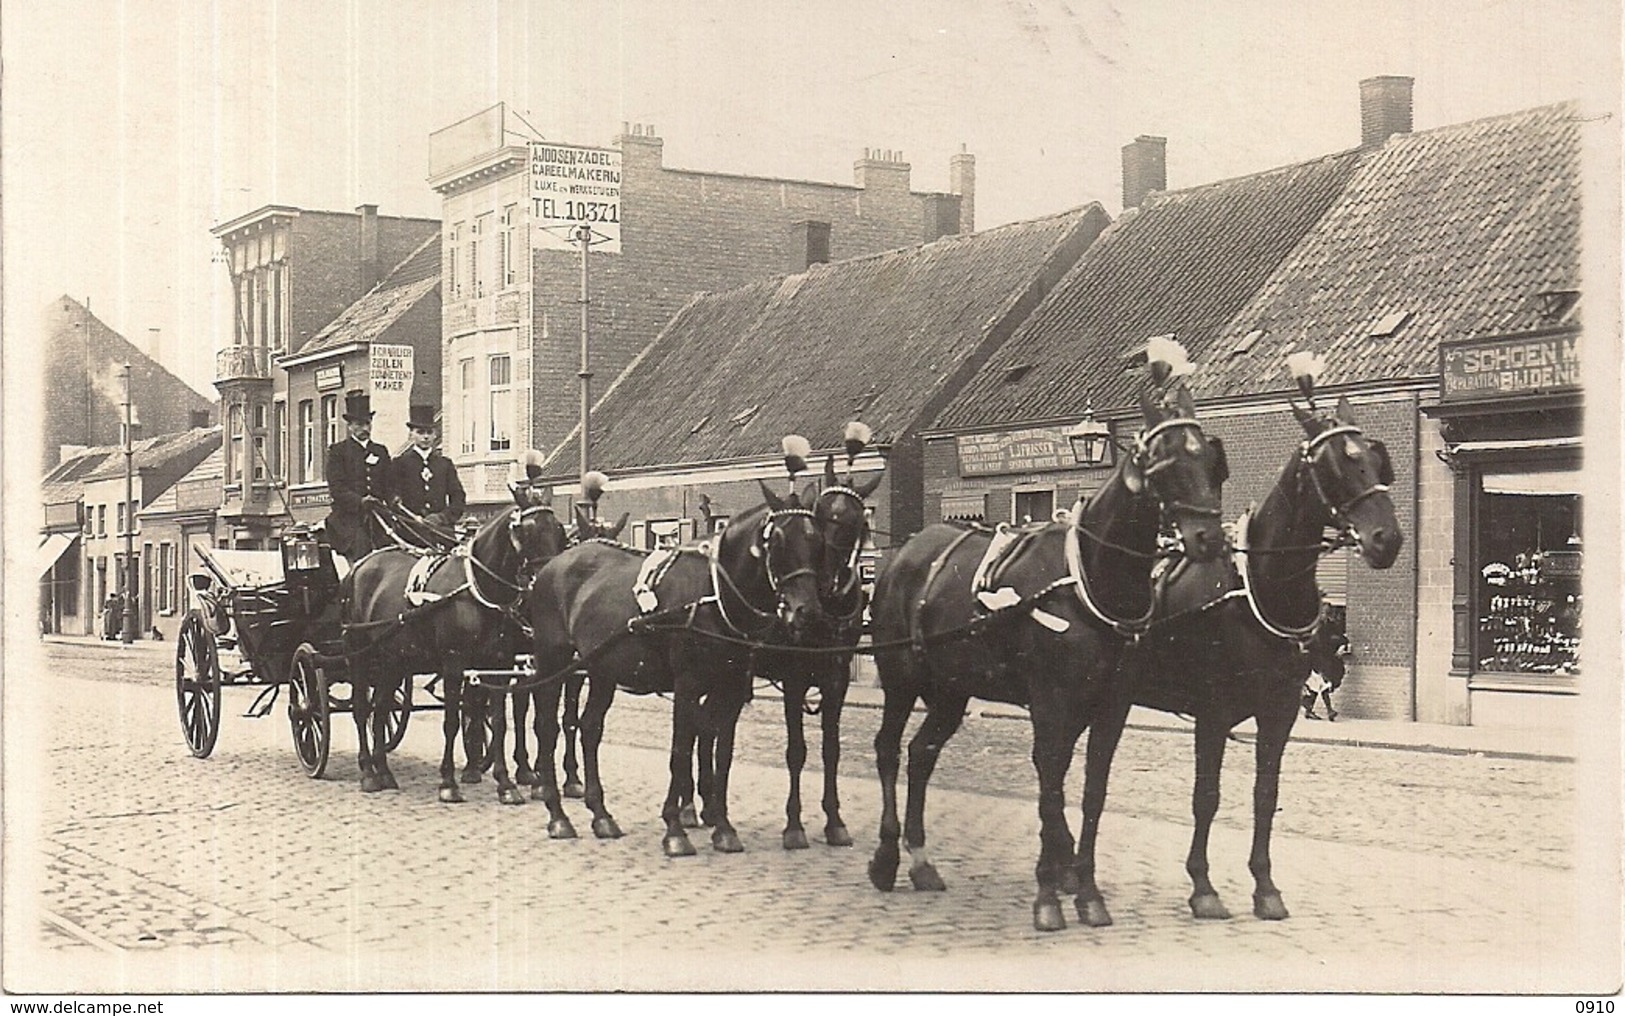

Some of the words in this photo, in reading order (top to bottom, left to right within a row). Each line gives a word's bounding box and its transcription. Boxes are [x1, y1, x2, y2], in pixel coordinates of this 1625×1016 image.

[577, 151, 611, 166] ZADEL
[535, 180, 557, 192] LUXE
[1463, 341, 1558, 374] SCHOEN
